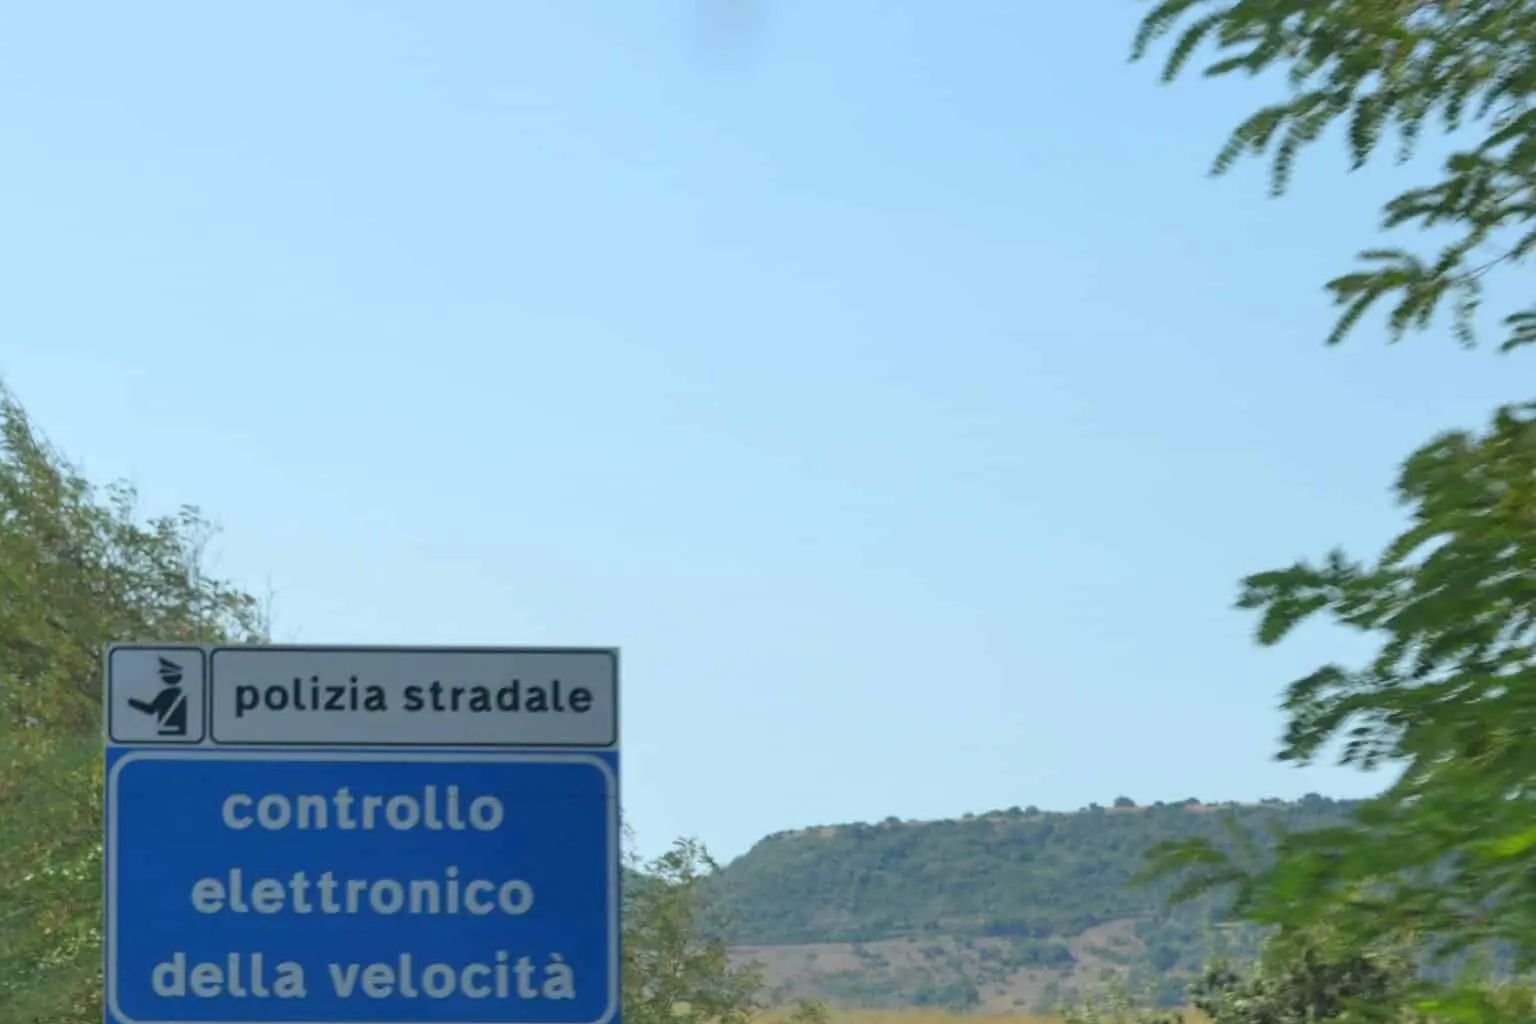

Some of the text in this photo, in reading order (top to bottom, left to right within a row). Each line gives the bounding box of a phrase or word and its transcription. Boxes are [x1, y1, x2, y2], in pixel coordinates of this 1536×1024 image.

[235, 676, 594, 718] polizia stradale
[222, 785, 504, 830] controllo
[192, 866, 534, 915] elettronico
[152, 950, 576, 1000] della velocità
